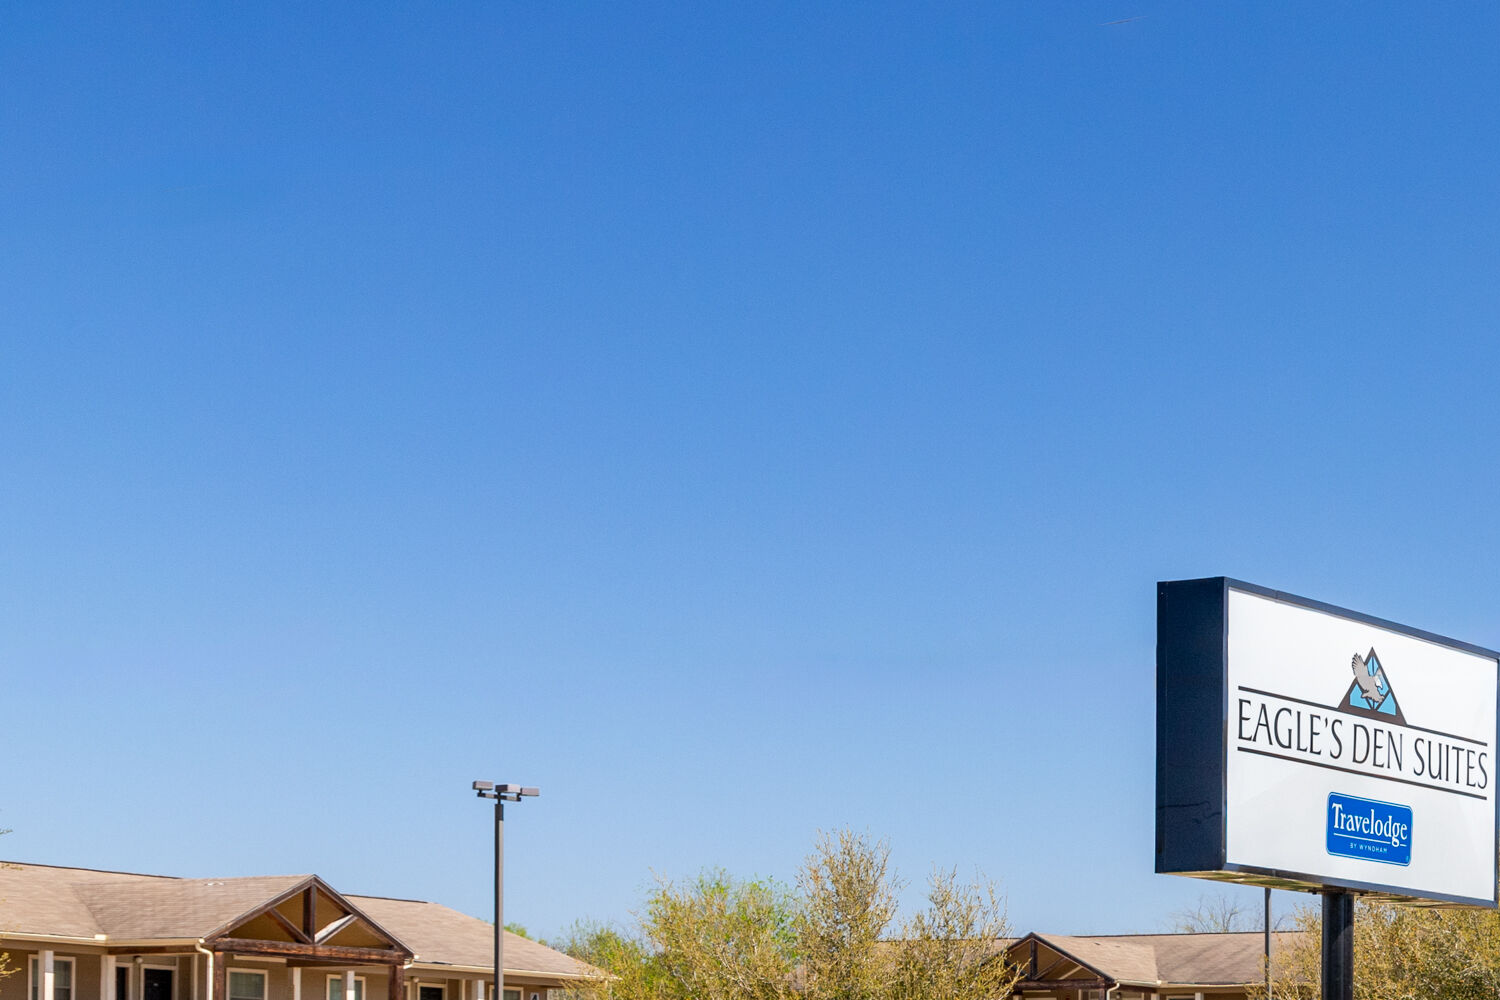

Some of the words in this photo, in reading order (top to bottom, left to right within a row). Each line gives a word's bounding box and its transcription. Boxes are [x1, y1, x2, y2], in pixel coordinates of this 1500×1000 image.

[1237, 698, 1343, 760] EAGLE'S
[1352, 723, 1403, 772] DEN
[1413, 738, 1488, 790] SUITES
[1331, 802, 1408, 847] Travelodge
[1359, 845, 1388, 854] WYNDHAM
